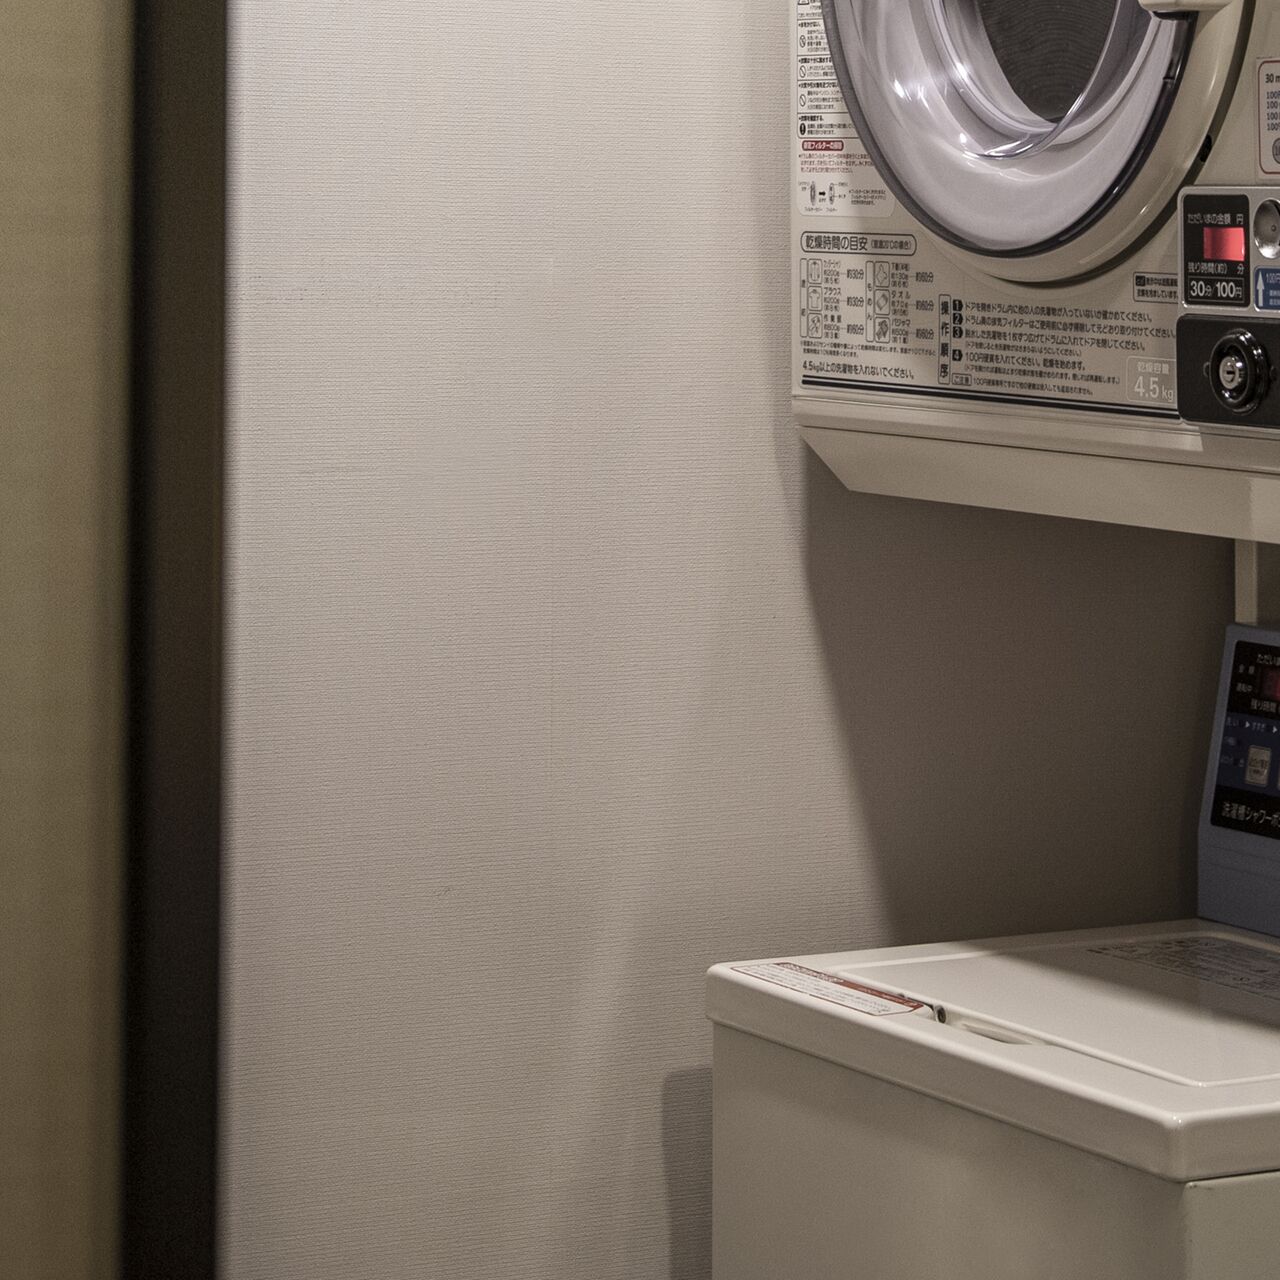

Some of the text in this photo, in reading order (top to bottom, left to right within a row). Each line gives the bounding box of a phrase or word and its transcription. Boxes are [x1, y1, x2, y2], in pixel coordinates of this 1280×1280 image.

[1265, 73, 1274, 83] 30
[1266, 101, 1278, 109] 100
[1236, 213, 1244, 225] 円
[806, 235, 868, 250] 乾燥時間の目安
[1237, 263, 1245, 275] 分
